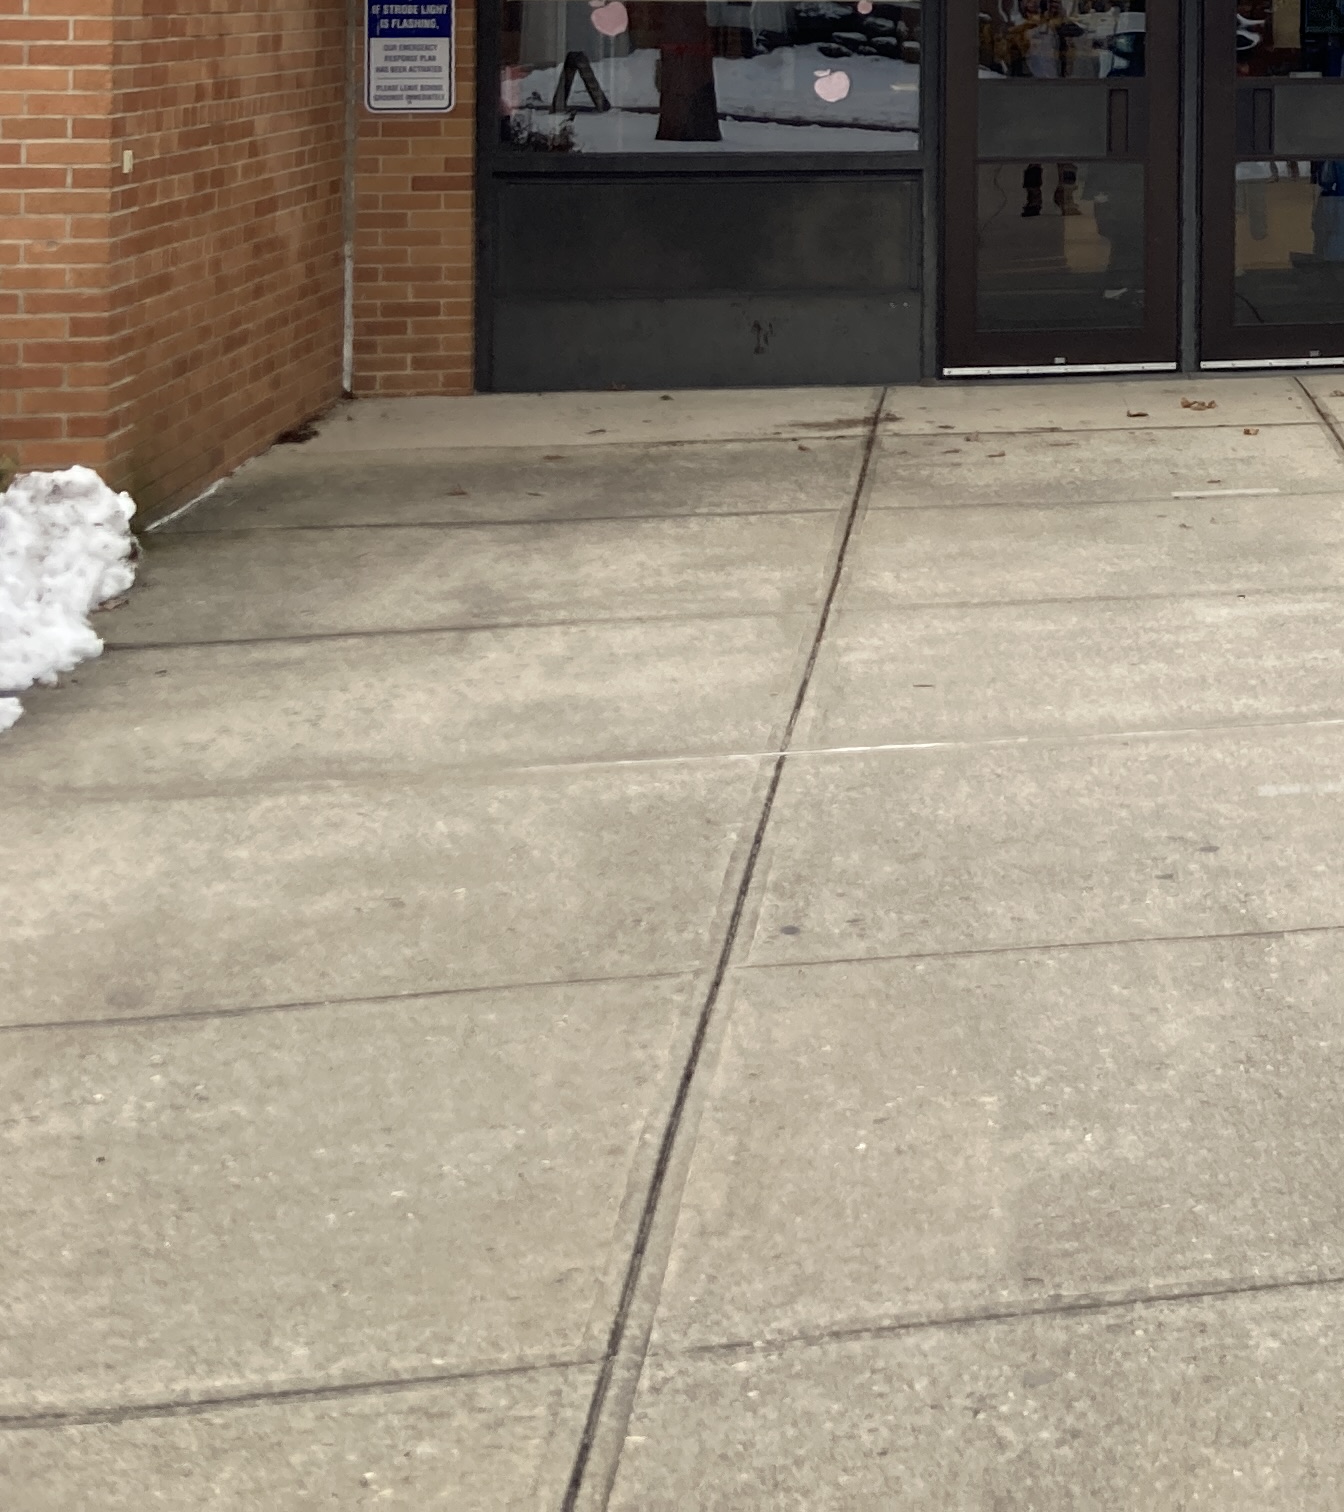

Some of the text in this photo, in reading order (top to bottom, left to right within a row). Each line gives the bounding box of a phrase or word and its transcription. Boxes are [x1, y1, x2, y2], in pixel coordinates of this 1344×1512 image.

[382, 4, 418, 14] STROBE
[421, 4, 448, 14] LIGHT
[380, 19, 389, 28] IS
